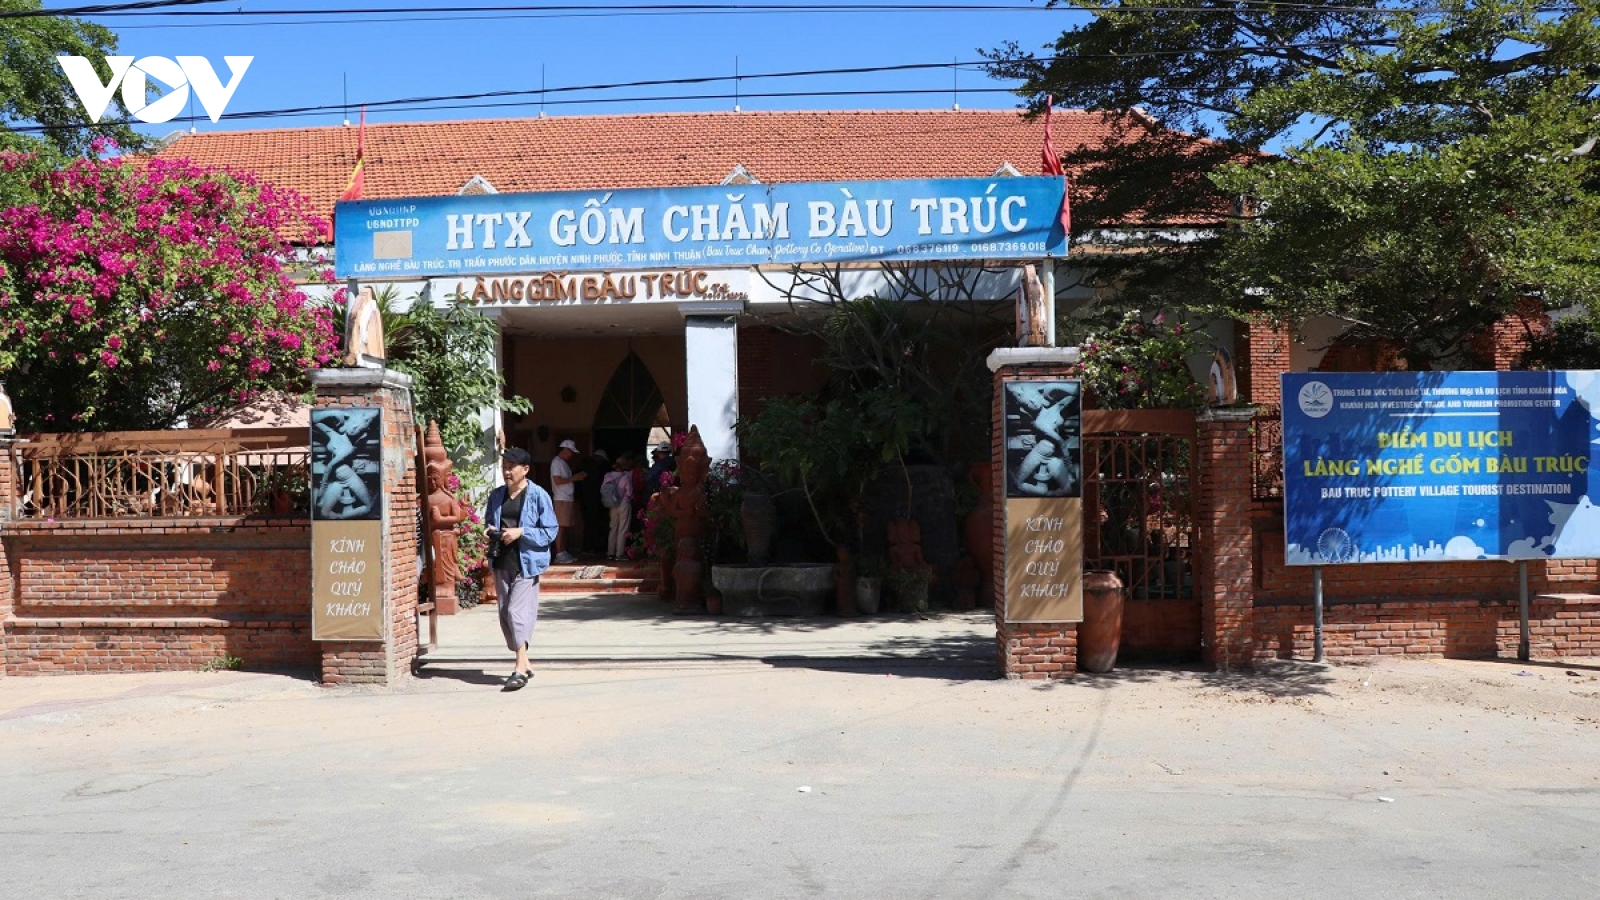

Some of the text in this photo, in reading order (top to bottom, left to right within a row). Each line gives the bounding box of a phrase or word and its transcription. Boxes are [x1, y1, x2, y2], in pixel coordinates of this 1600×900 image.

[446, 184, 1028, 250] HTX GỐM CHĂM BÀU TRÚC
[354, 262, 376, 273] LÀNG
[464, 254, 486, 268] TRẤN
[571, 254, 591, 264] NINH
[650, 251, 670, 262] NINH
[673, 249, 701, 263] THUẬN
[584, 270, 637, 300] BÀU
[640, 268, 708, 298] TRÚC
[1333, 388, 1356, 397] TRUNG
[1485, 387, 1494, 396] DU
[1447, 400, 1461, 408] AND
[1463, 400, 1493, 408] TOURISM
[1494, 399, 1534, 408] PROMOTION
[1535, 399, 1561, 408] CENTER
[1377, 425, 1513, 451] ĐIỂM DU LỊCH
[1303, 452, 1588, 477] LÀNG NGHỀ GỐM BÀU TRÚC
[1321, 483, 1571, 499] BAU TRUC POTTERY VILLAGE TOURIST DESTINATION
[1025, 514, 1063, 532] KÍNH
[330, 536, 365, 553] KÍNH
[1026, 559, 1060, 577] QUÝ
[330, 579, 362, 597] QUÝ
[1020, 580, 1068, 597] KHÁCH
[326, 600, 371, 616] KHÁCH
